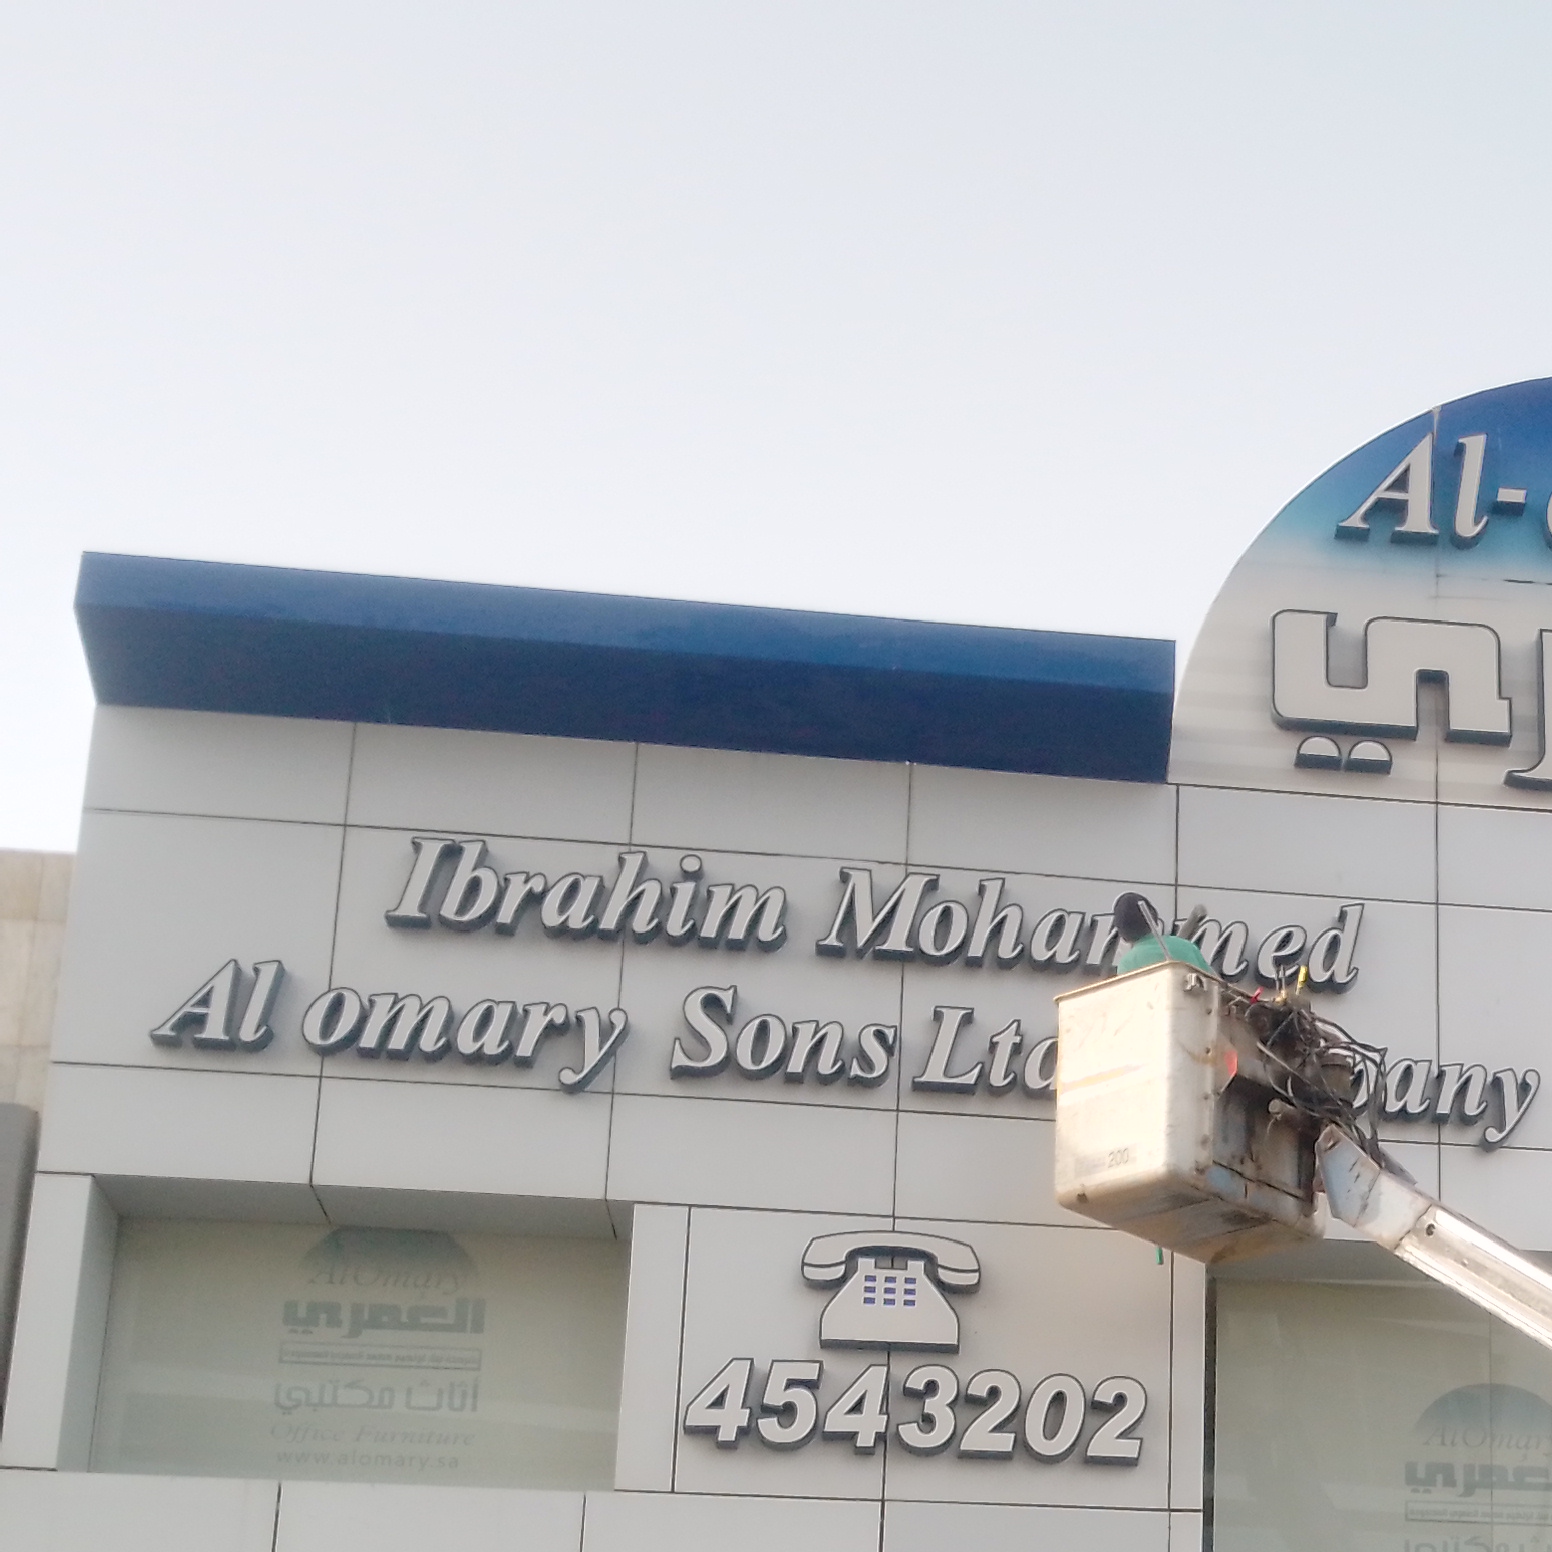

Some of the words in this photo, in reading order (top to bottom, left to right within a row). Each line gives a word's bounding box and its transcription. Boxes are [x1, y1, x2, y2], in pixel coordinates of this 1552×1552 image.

[385, 835, 787, 951] Ibrahim
[151, 958, 288, 1053] Al
[301, 986, 631, 1094] omary
[668, 983, 900, 1091] Sons
[683, 1357, 1148, 1466] 4543202
